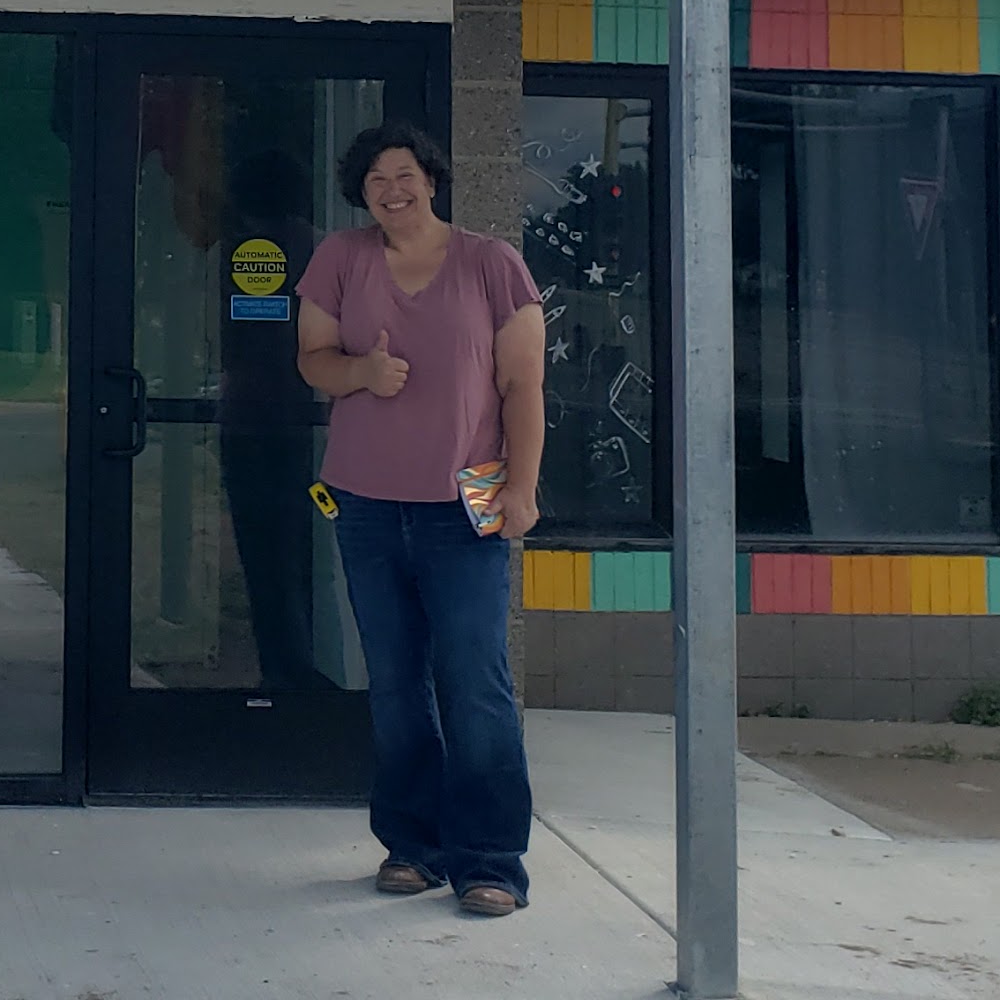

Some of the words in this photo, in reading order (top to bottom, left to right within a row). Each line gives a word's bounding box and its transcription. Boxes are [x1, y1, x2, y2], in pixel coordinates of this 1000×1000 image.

[234, 251, 283, 259] AUTOMATIC
[233, 262, 285, 273] CAUTION
[247, 276, 272, 284] DOOR
